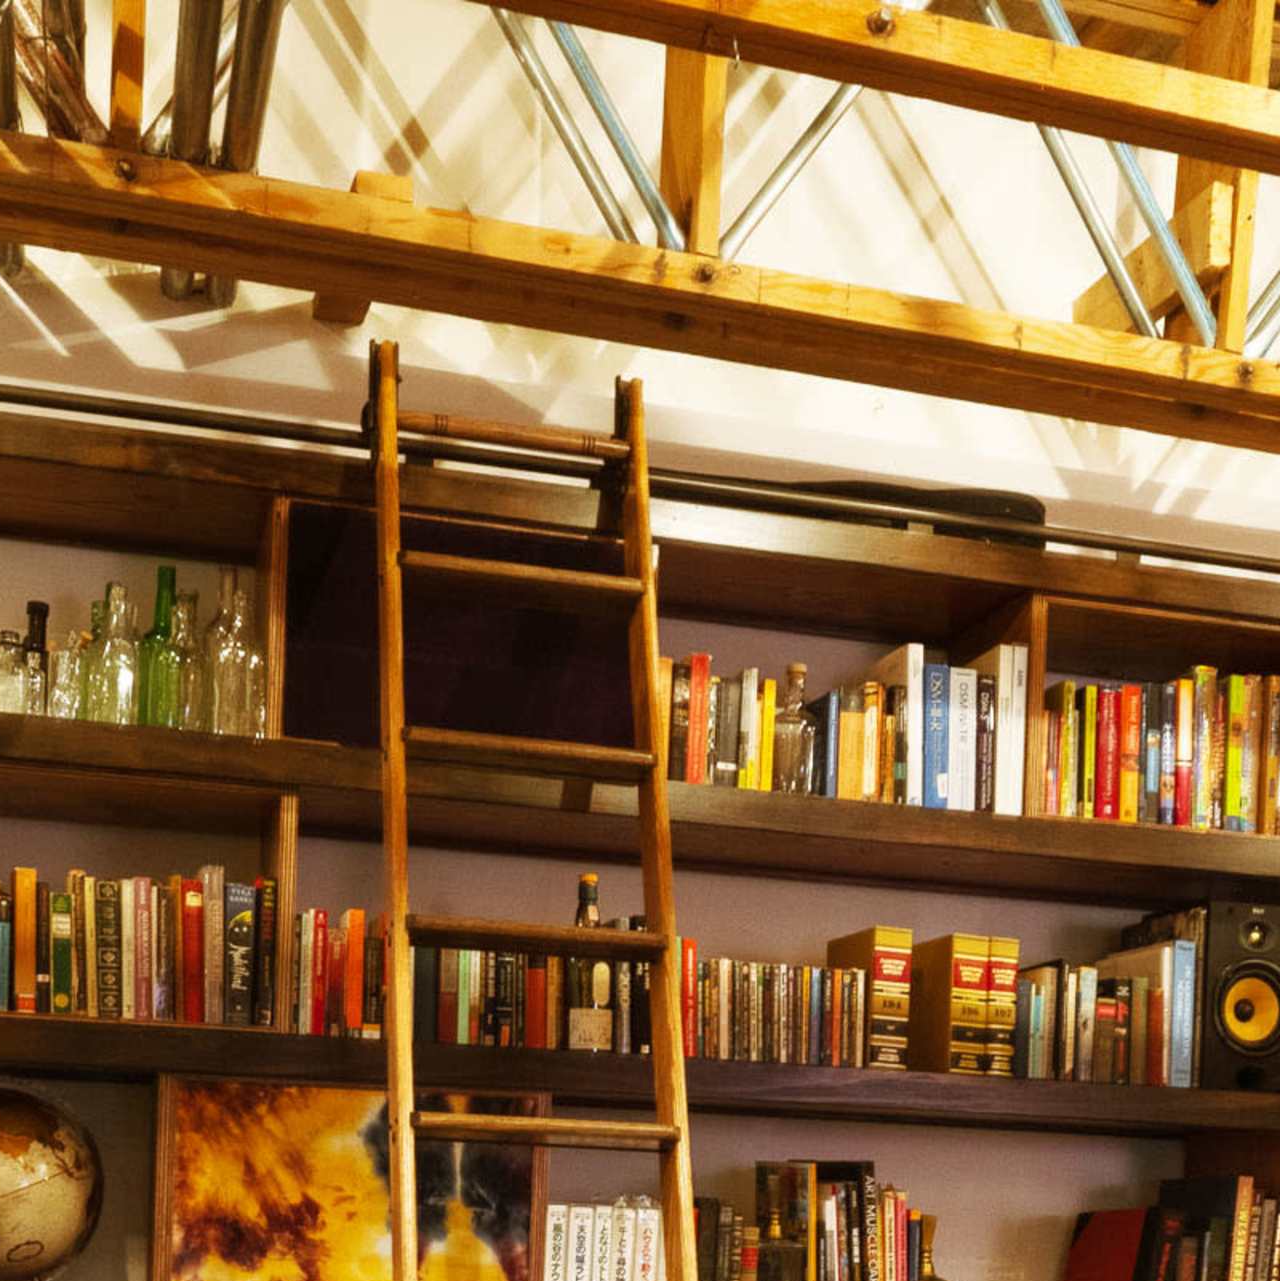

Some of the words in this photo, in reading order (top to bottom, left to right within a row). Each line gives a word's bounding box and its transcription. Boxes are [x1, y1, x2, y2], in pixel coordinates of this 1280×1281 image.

[864, 1175, 875, 1198] ART
[866, 1204, 879, 1258] MUSCLE
[1236, 1210, 1248, 1236] WES
[1251, 1217, 1260, 1232] THE
[1248, 1234, 1258, 1265] GRAND
